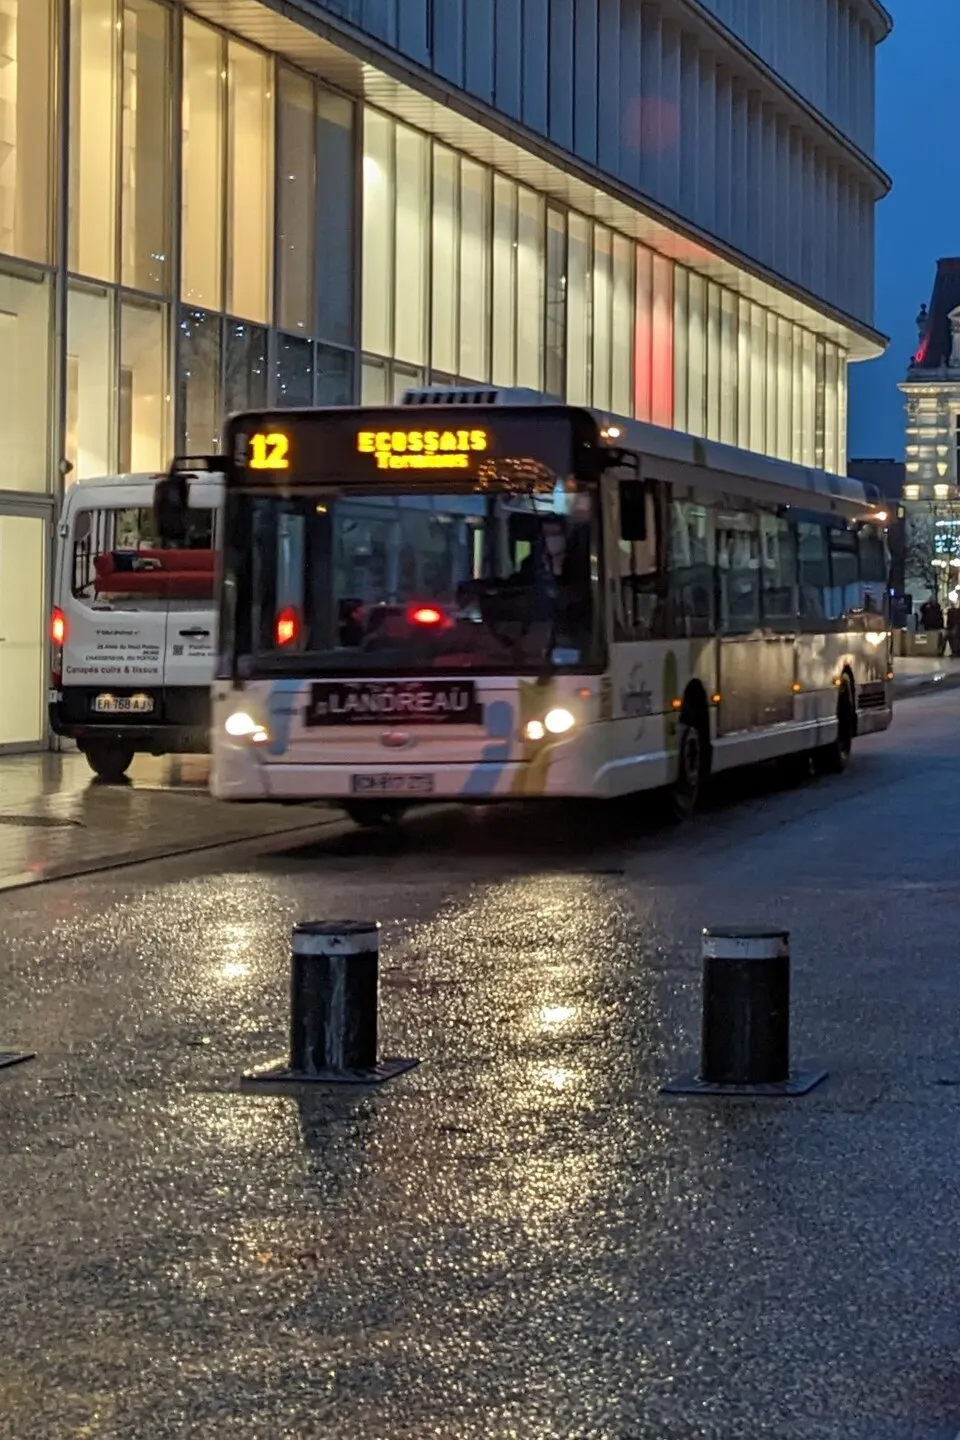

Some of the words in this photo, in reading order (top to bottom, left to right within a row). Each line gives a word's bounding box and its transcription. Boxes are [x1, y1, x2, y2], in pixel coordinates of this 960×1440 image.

[250, 433, 289, 469] 12
[358, 430, 487, 452] ECOSSAIS
[66, 665, 99, 675] Canapés
[101, 665, 121, 674] cuirs
[124, 665, 130, 674] &
[132, 665, 158, 674] tissus
[328, 689, 470, 713] LANDREAU
